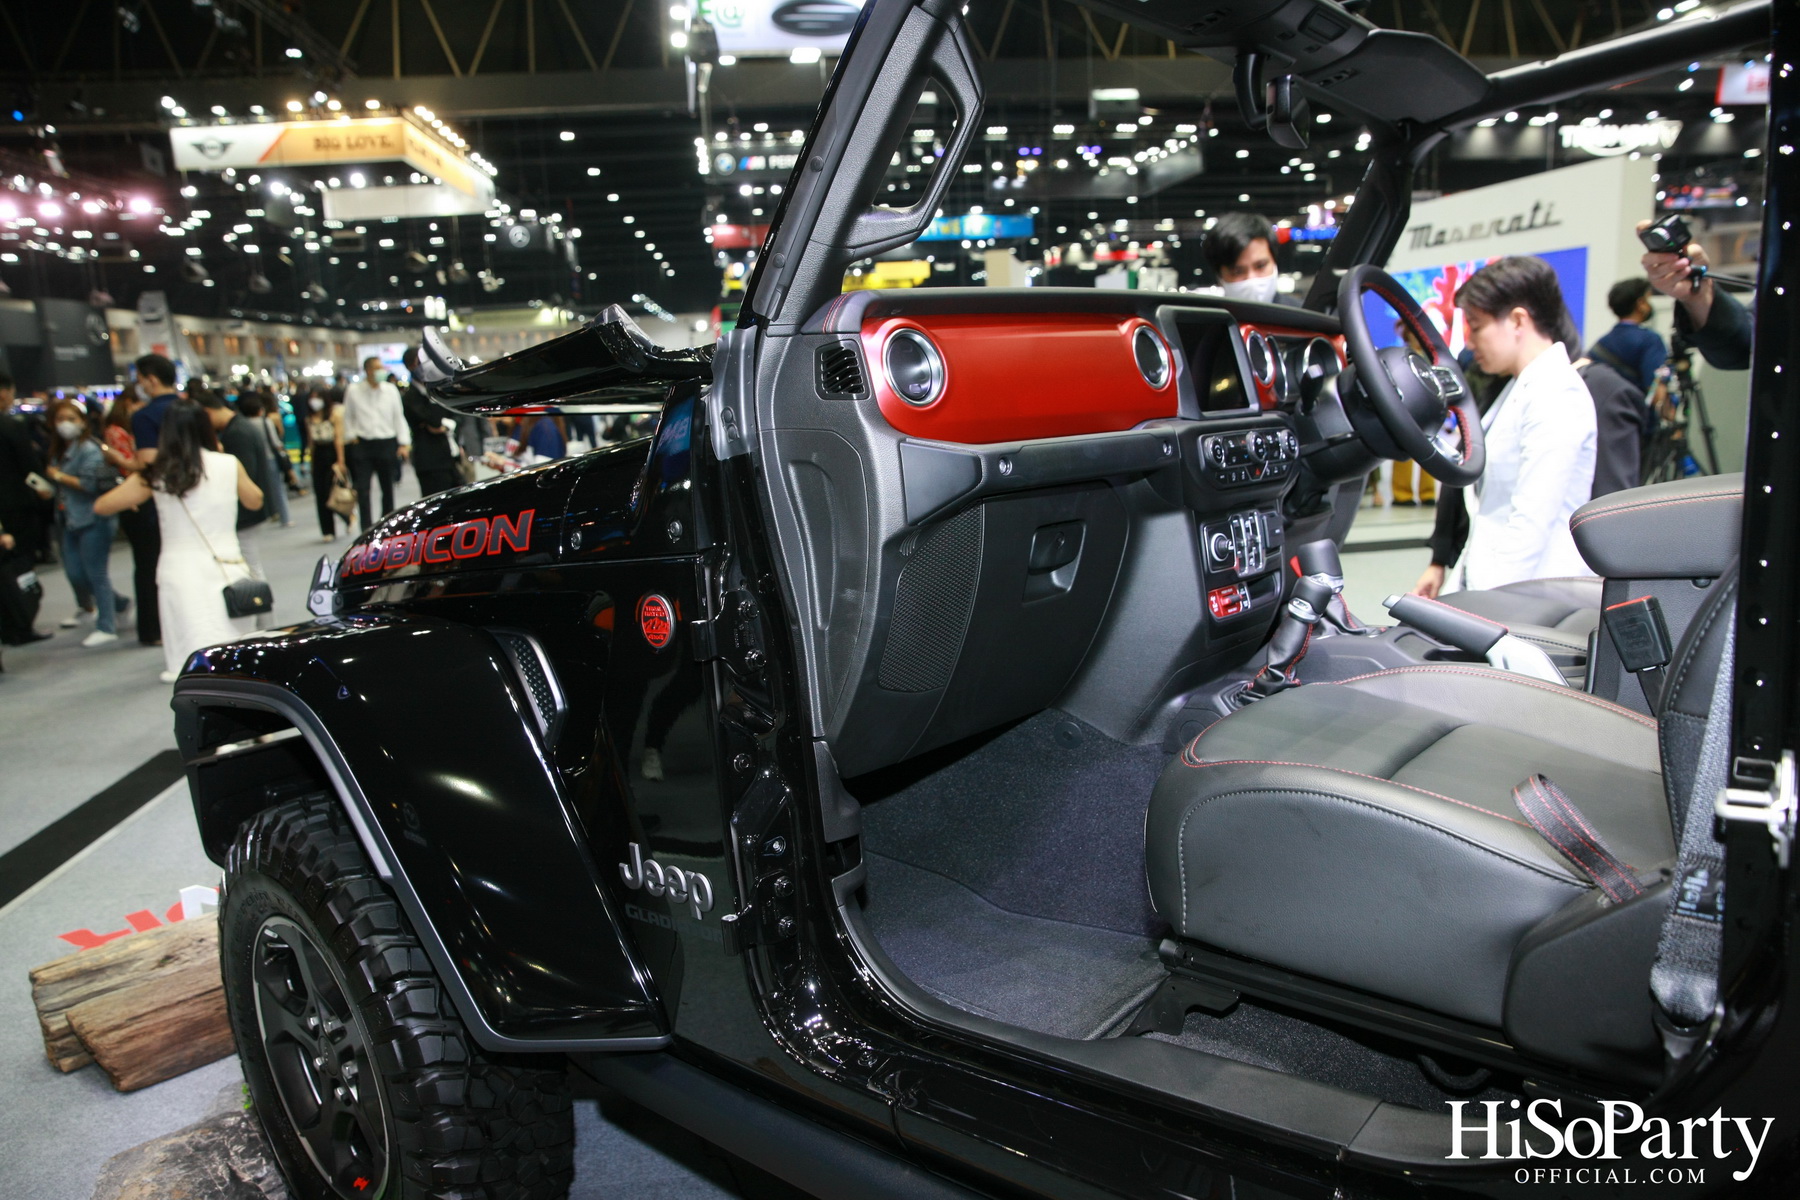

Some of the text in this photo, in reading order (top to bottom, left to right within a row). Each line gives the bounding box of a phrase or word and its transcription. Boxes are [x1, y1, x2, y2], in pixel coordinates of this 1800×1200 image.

[1407, 201, 1562, 251] Maserati
[341, 508, 535, 577] RUBICON
[618, 842, 713, 920] Jeep
